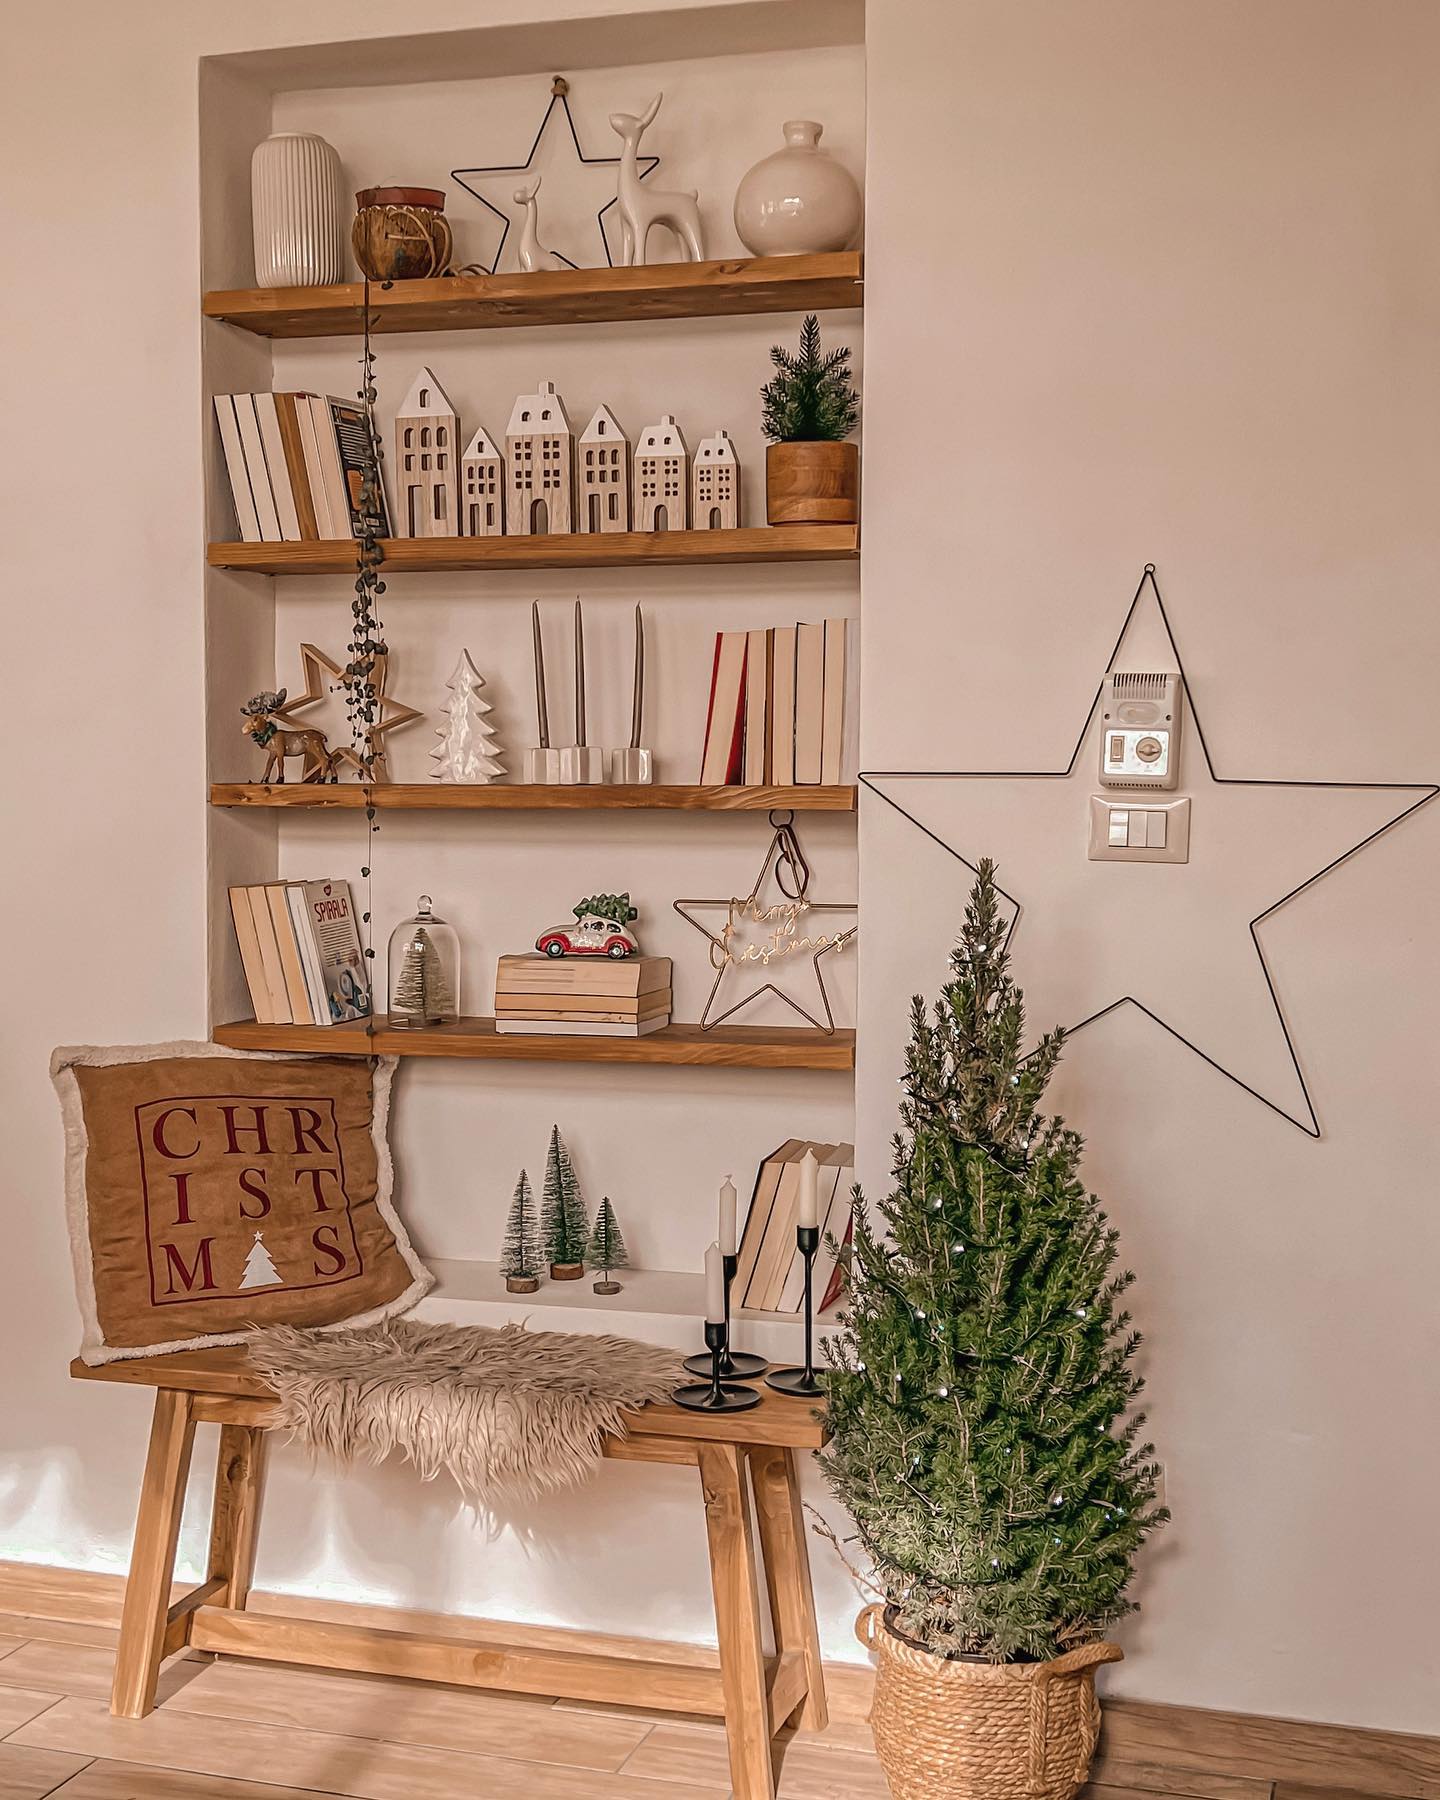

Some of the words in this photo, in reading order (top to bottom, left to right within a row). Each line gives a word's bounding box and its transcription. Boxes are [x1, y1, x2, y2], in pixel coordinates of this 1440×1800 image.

[314, 898, 349, 922] SPIRALA
[729, 895, 811, 936] Merry
[152, 1105, 334, 1160] CHR
[168, 1167, 339, 1226] IST
